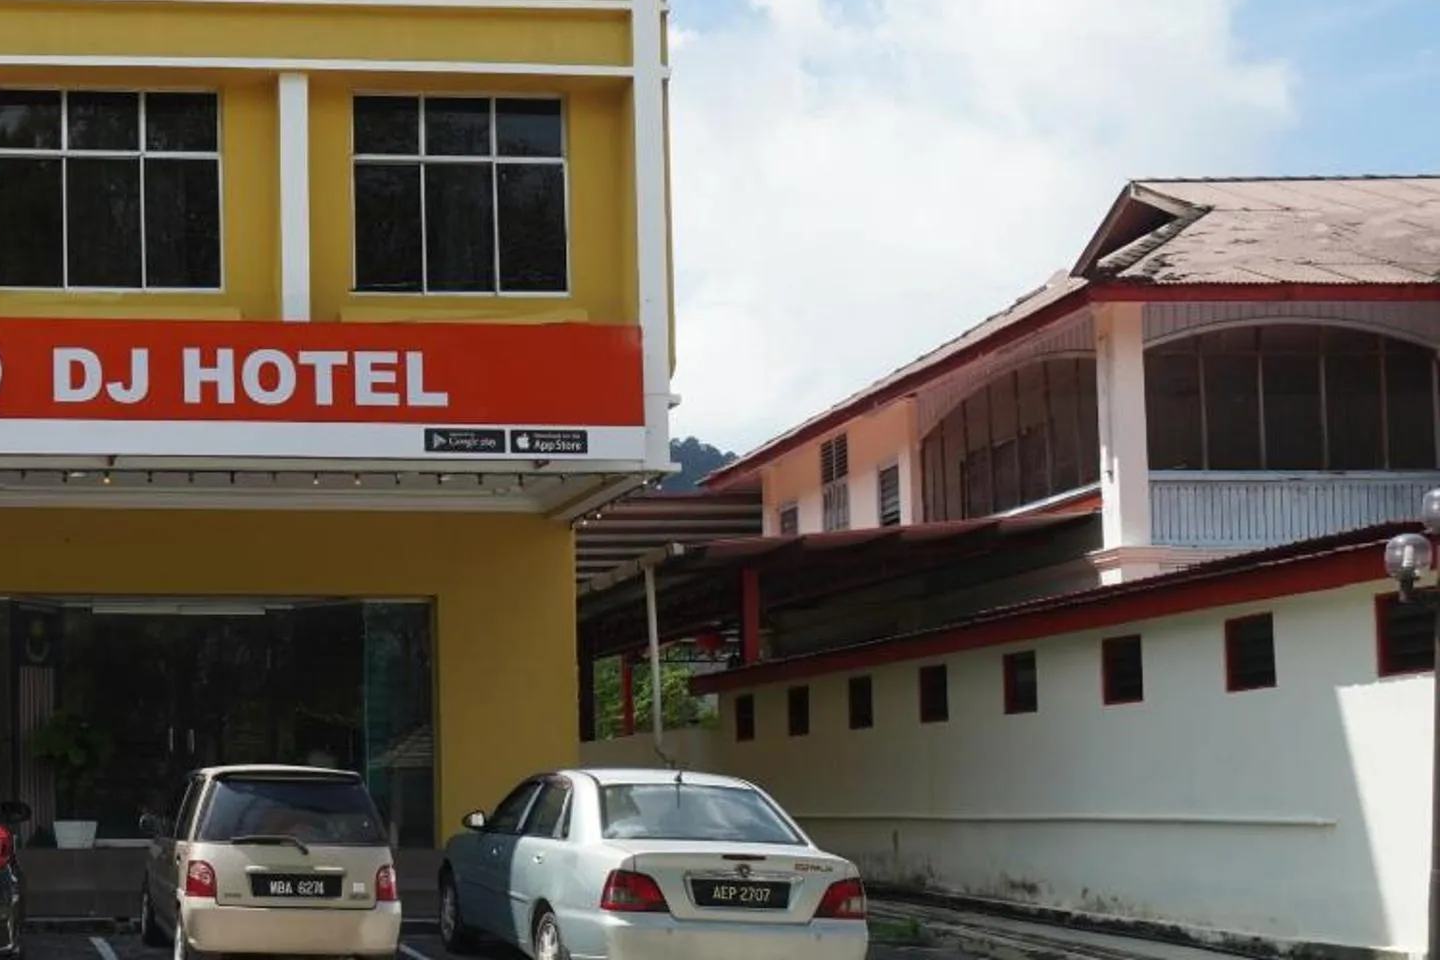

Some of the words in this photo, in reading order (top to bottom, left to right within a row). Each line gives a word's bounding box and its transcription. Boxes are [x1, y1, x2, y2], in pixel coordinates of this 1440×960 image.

[53, 347, 149, 403] DJ
[182, 347, 448, 407] HOTEL
[270, 881, 293, 894] WBA
[713, 885, 737, 900] AEP
[739, 886, 771, 902] 2707
